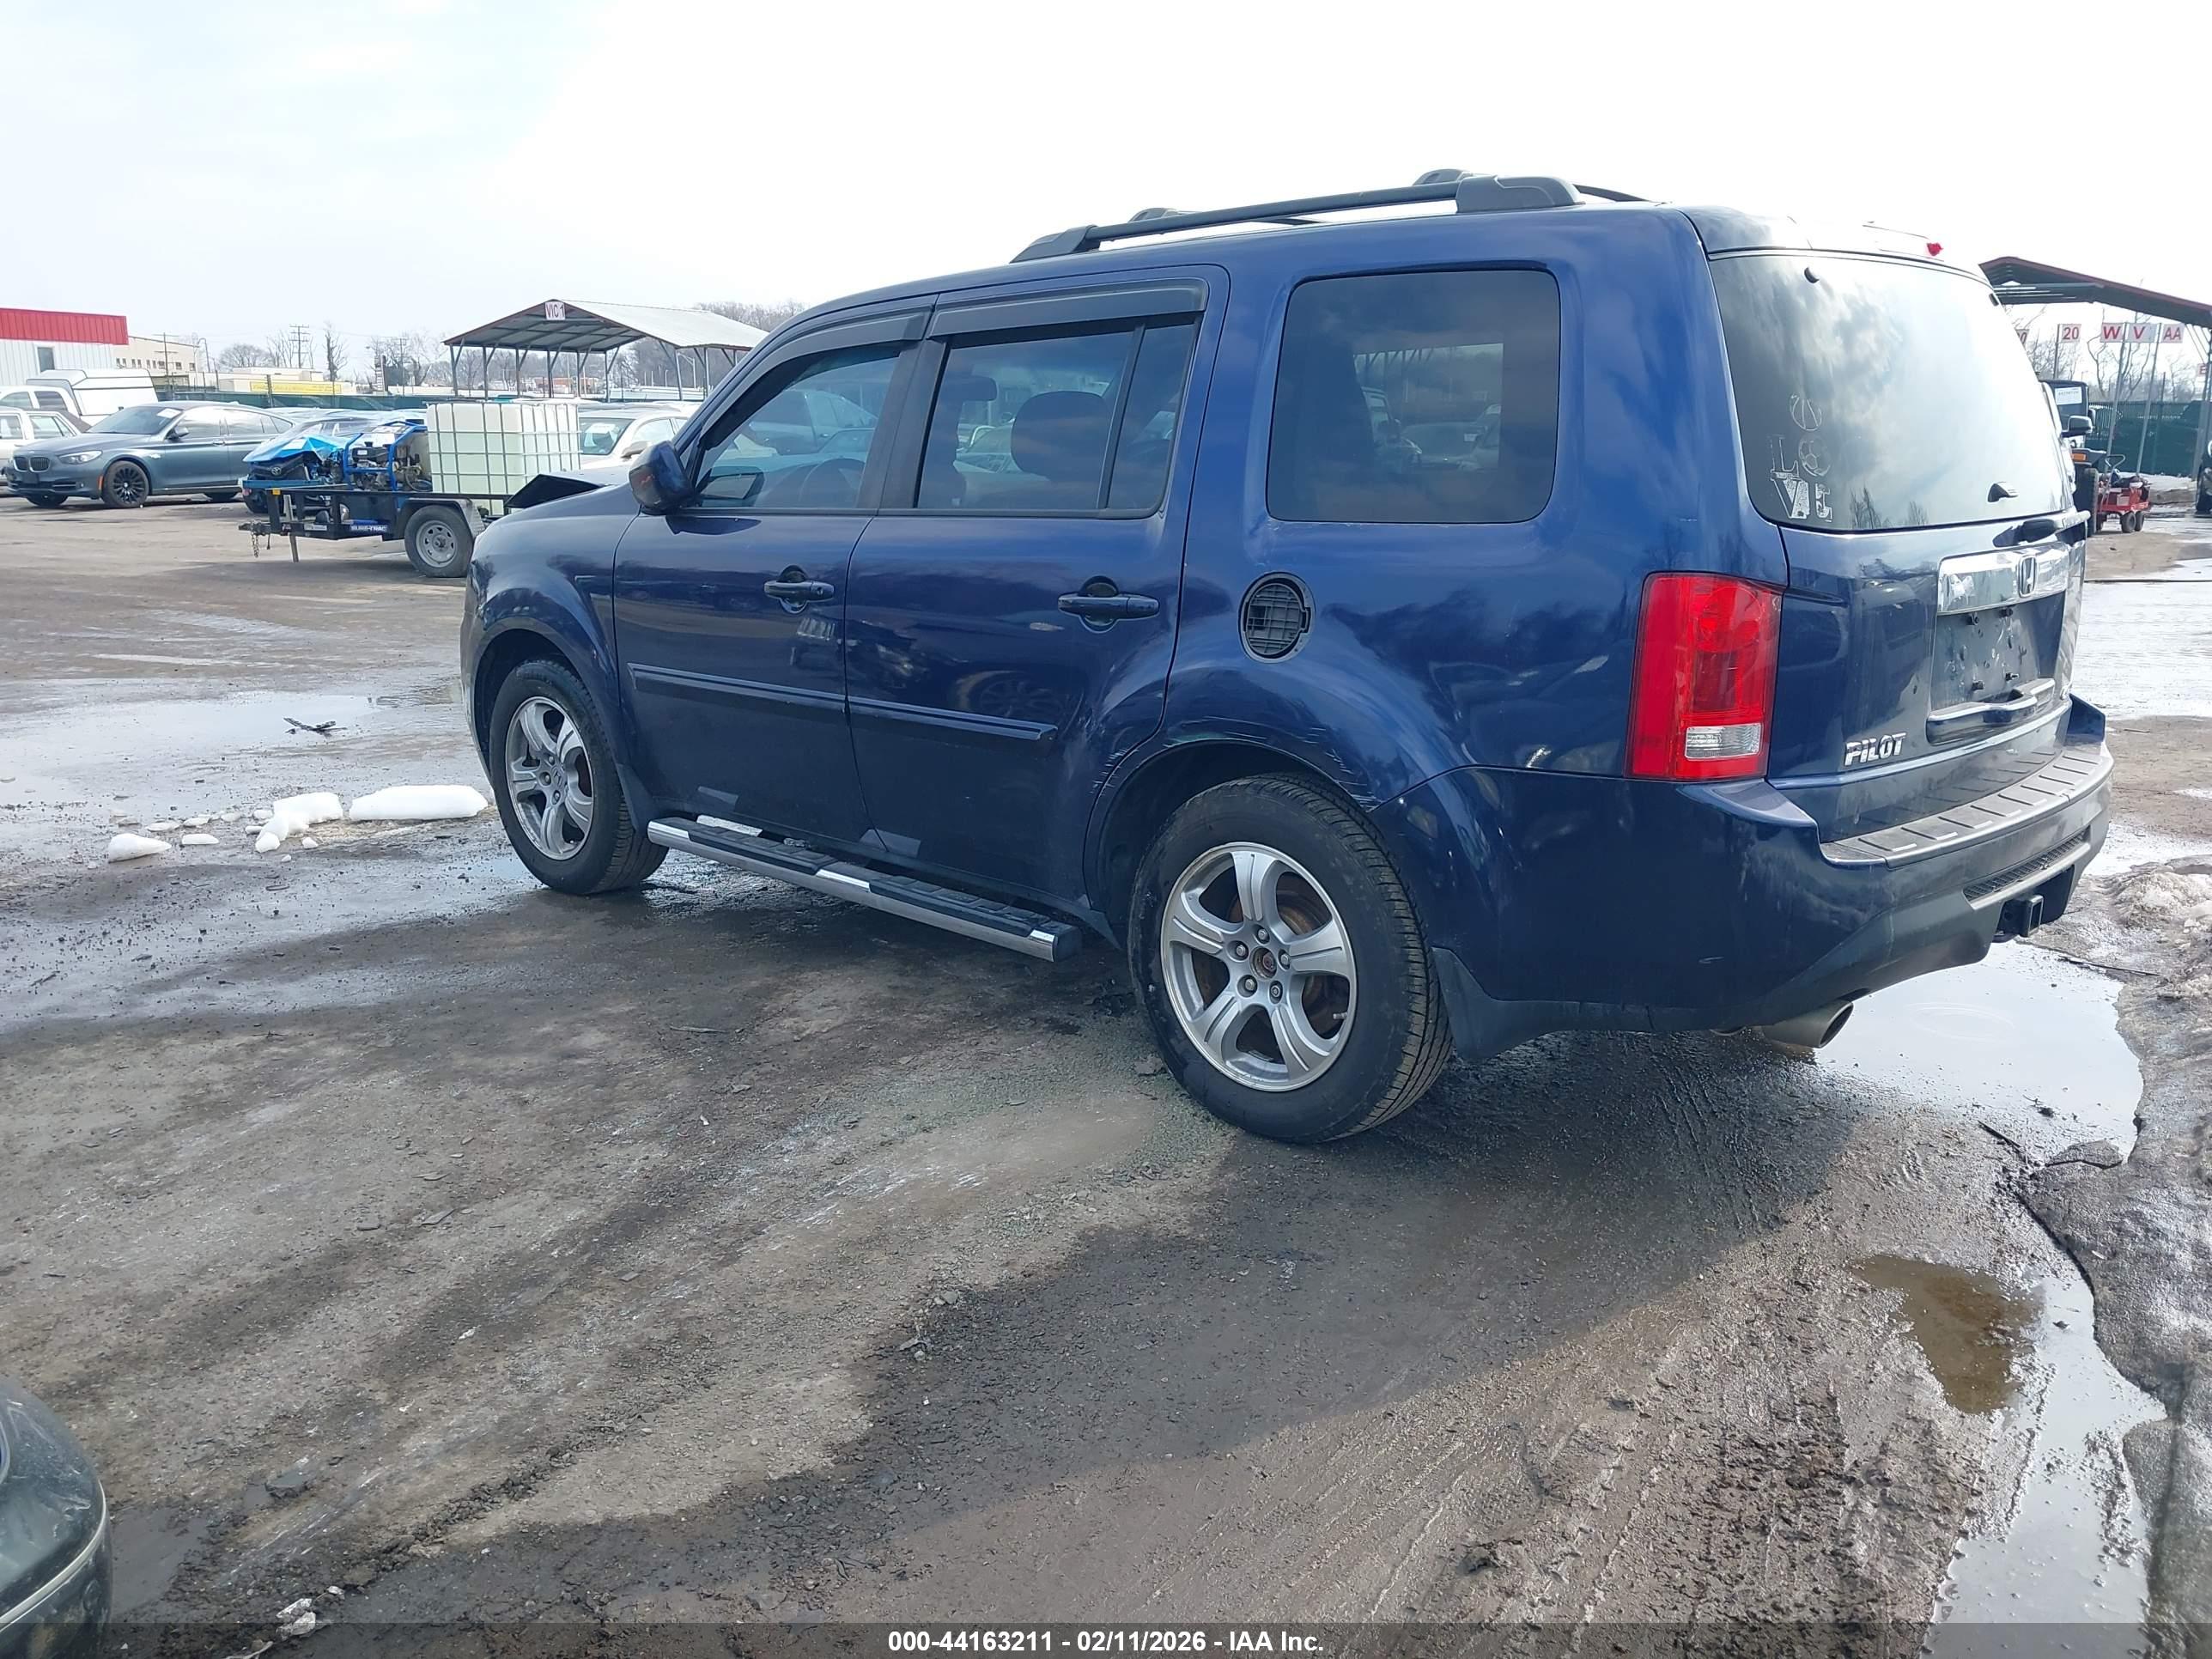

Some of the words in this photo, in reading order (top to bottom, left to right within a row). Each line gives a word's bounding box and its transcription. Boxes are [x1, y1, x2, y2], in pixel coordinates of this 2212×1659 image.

[545, 304, 559, 319] VIC
[560, 304, 565, 317] 1
[2063, 326, 2080, 340] 20
[2103, 326, 2121, 339] W
[2133, 326, 2145, 339] V
[2163, 326, 2182, 340] AA
[1844, 732, 1907, 766] PILOT
